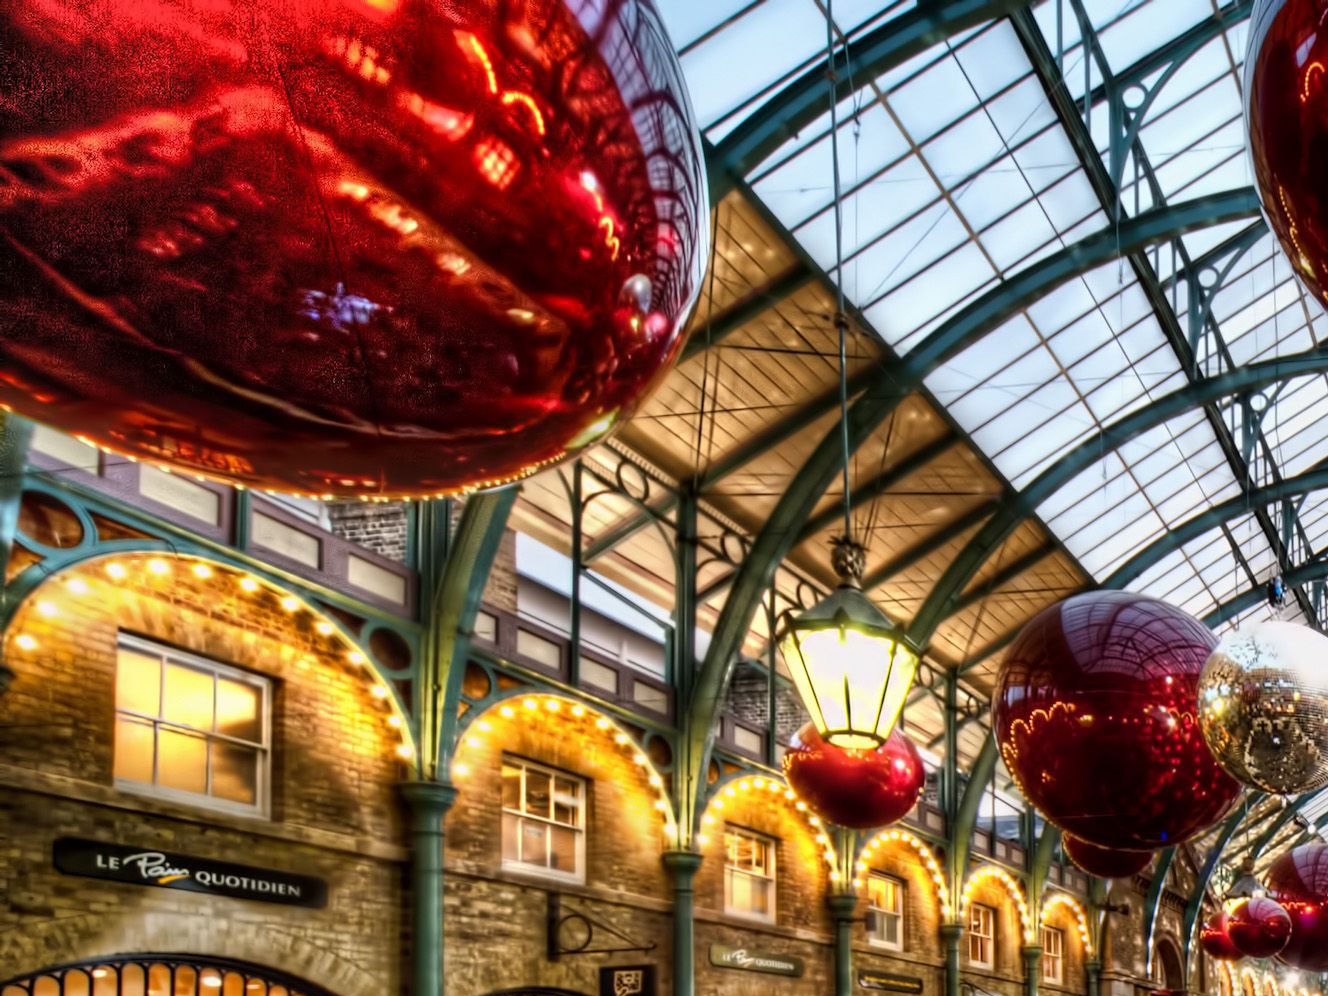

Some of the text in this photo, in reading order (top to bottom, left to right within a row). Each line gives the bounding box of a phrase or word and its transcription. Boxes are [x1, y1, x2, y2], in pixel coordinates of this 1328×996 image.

[96, 852, 301, 897] LE Pain QUOTIDIEN
